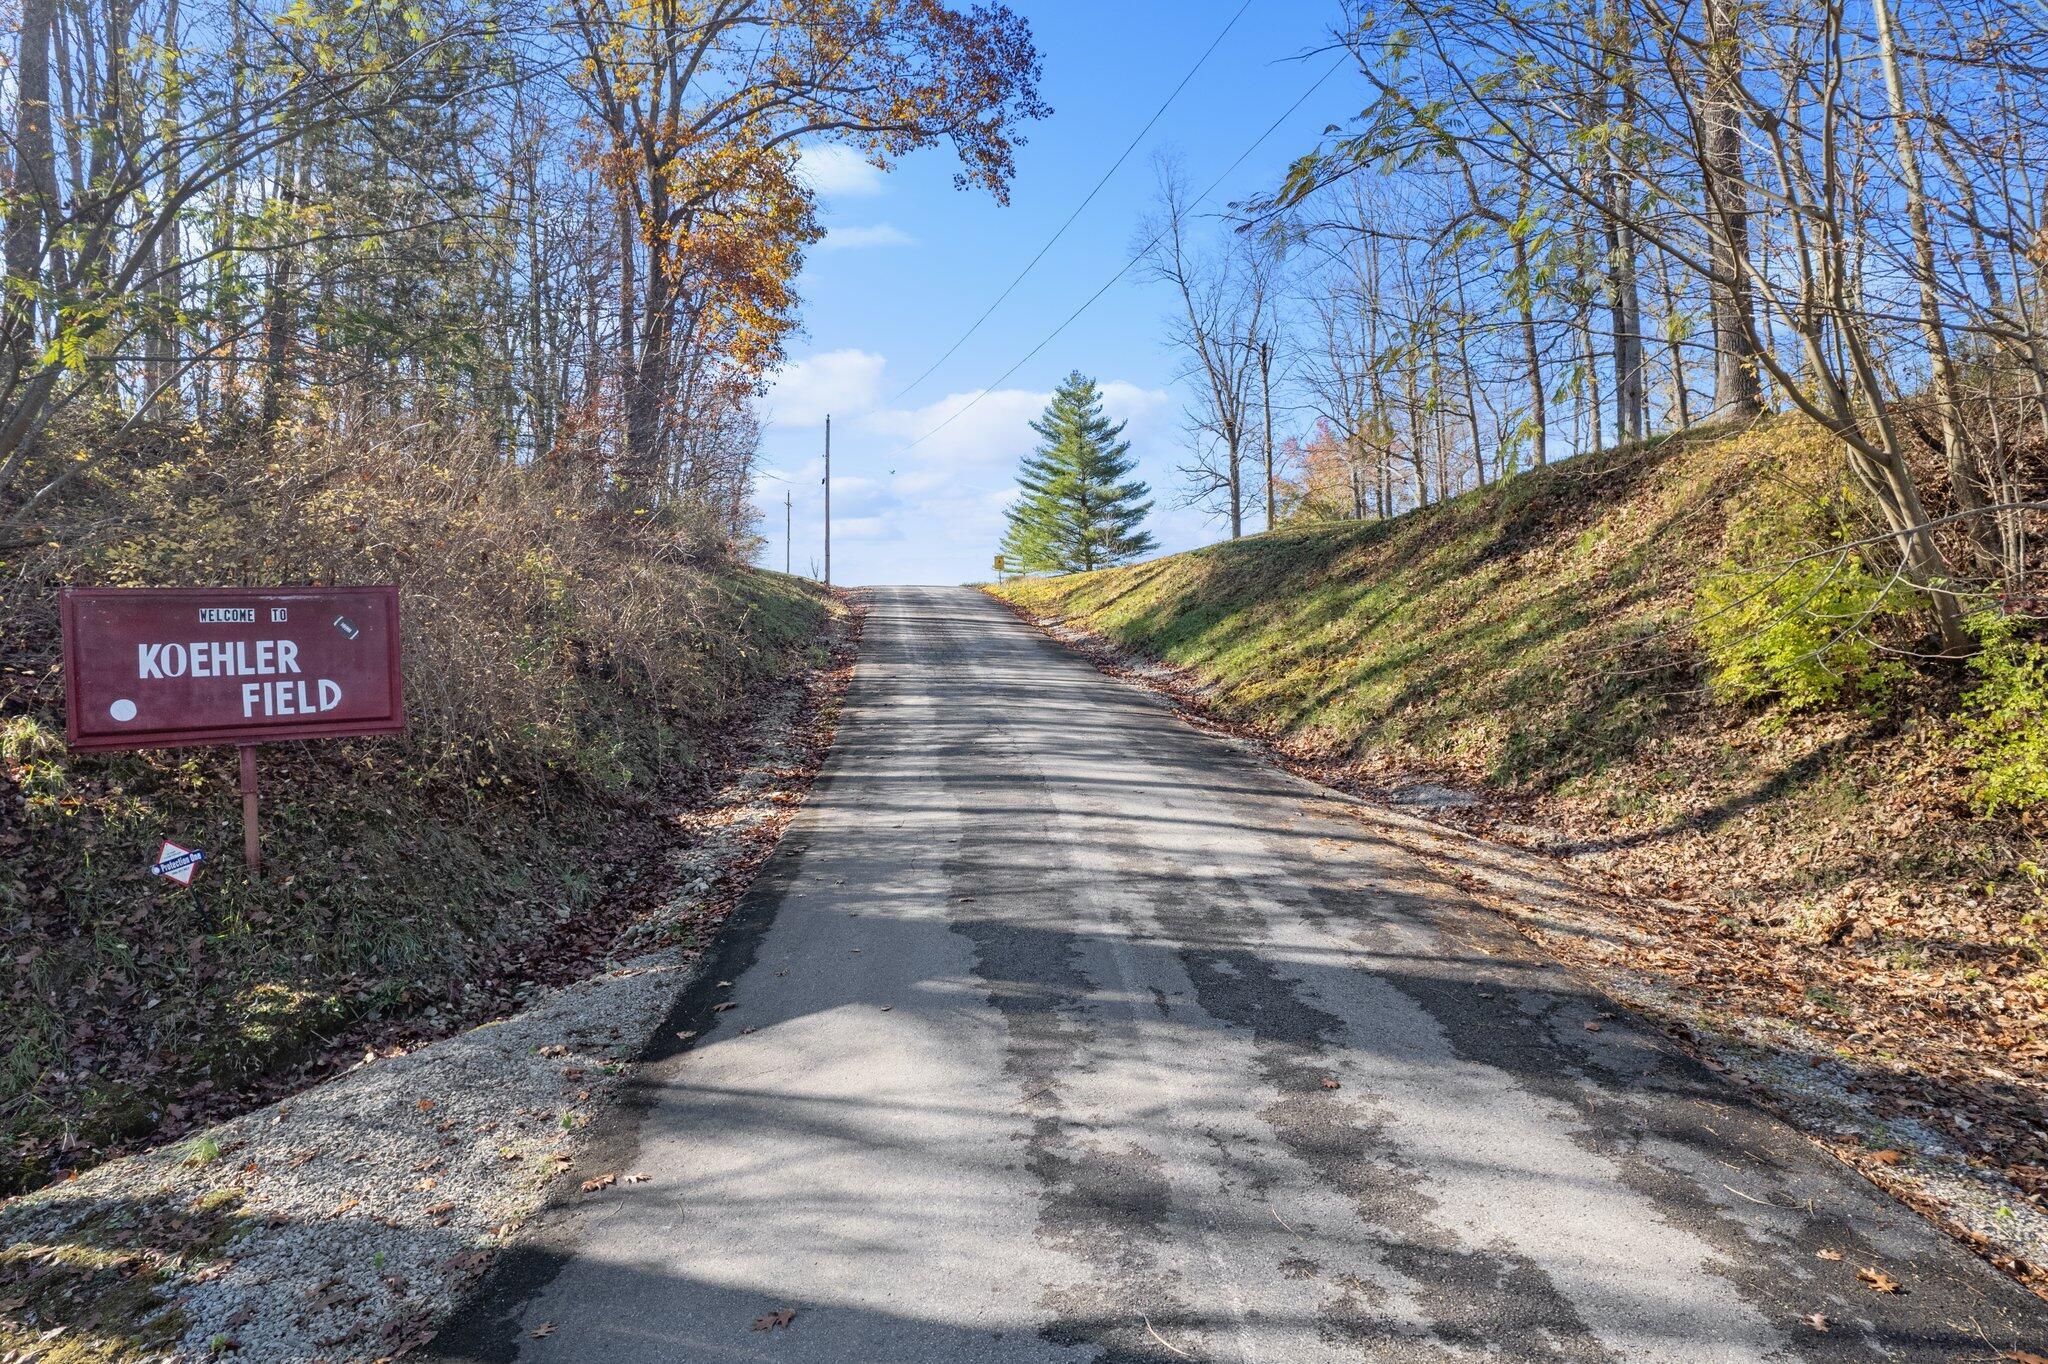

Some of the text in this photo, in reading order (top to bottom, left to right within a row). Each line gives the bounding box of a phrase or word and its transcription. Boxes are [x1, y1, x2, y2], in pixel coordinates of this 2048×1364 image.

[200, 608, 287, 622] WELCOME TO
[138, 640, 301, 679] KOEHLER
[242, 679, 342, 717] FIELD
[160, 855, 190, 872] Protection
[190, 852, 202, 862] One
